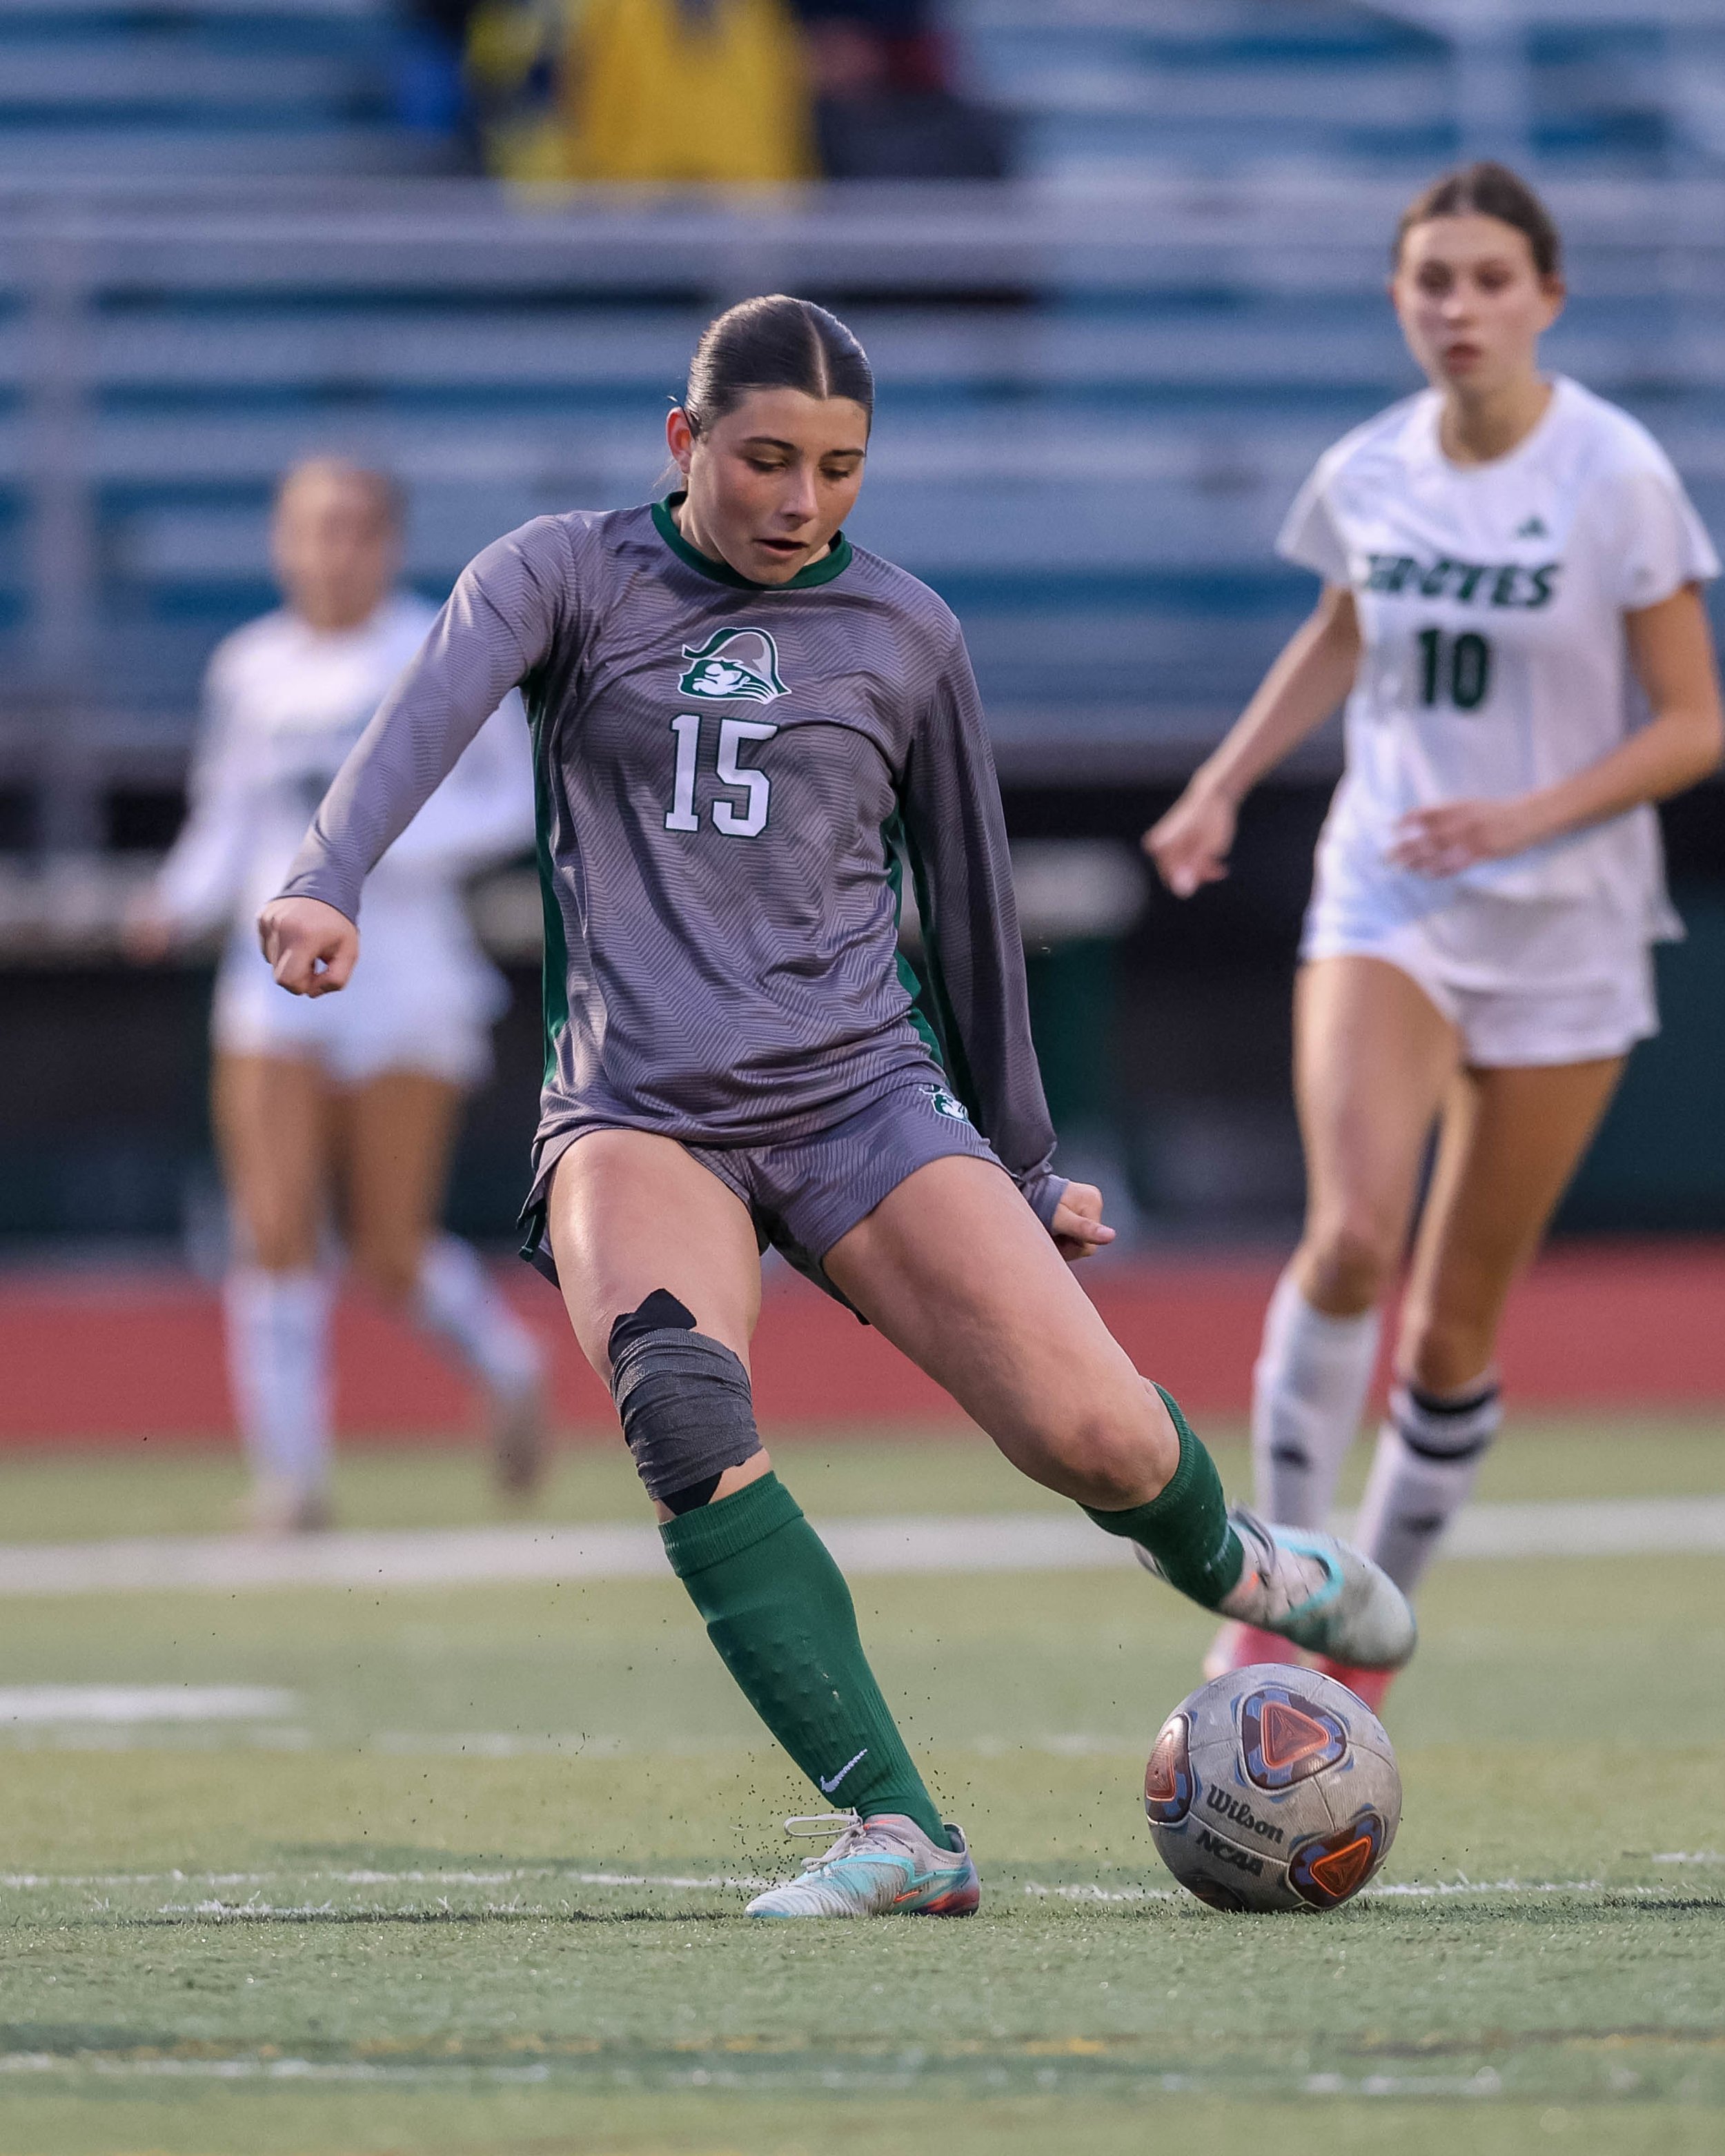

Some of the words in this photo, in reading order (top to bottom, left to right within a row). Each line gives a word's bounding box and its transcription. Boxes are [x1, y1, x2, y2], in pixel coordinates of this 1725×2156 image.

[1417, 626, 1490, 710] 10
[664, 713, 778, 838] 15
[1207, 1783, 1283, 1844] Wilson
[1196, 1830, 1263, 1877] NCAA
